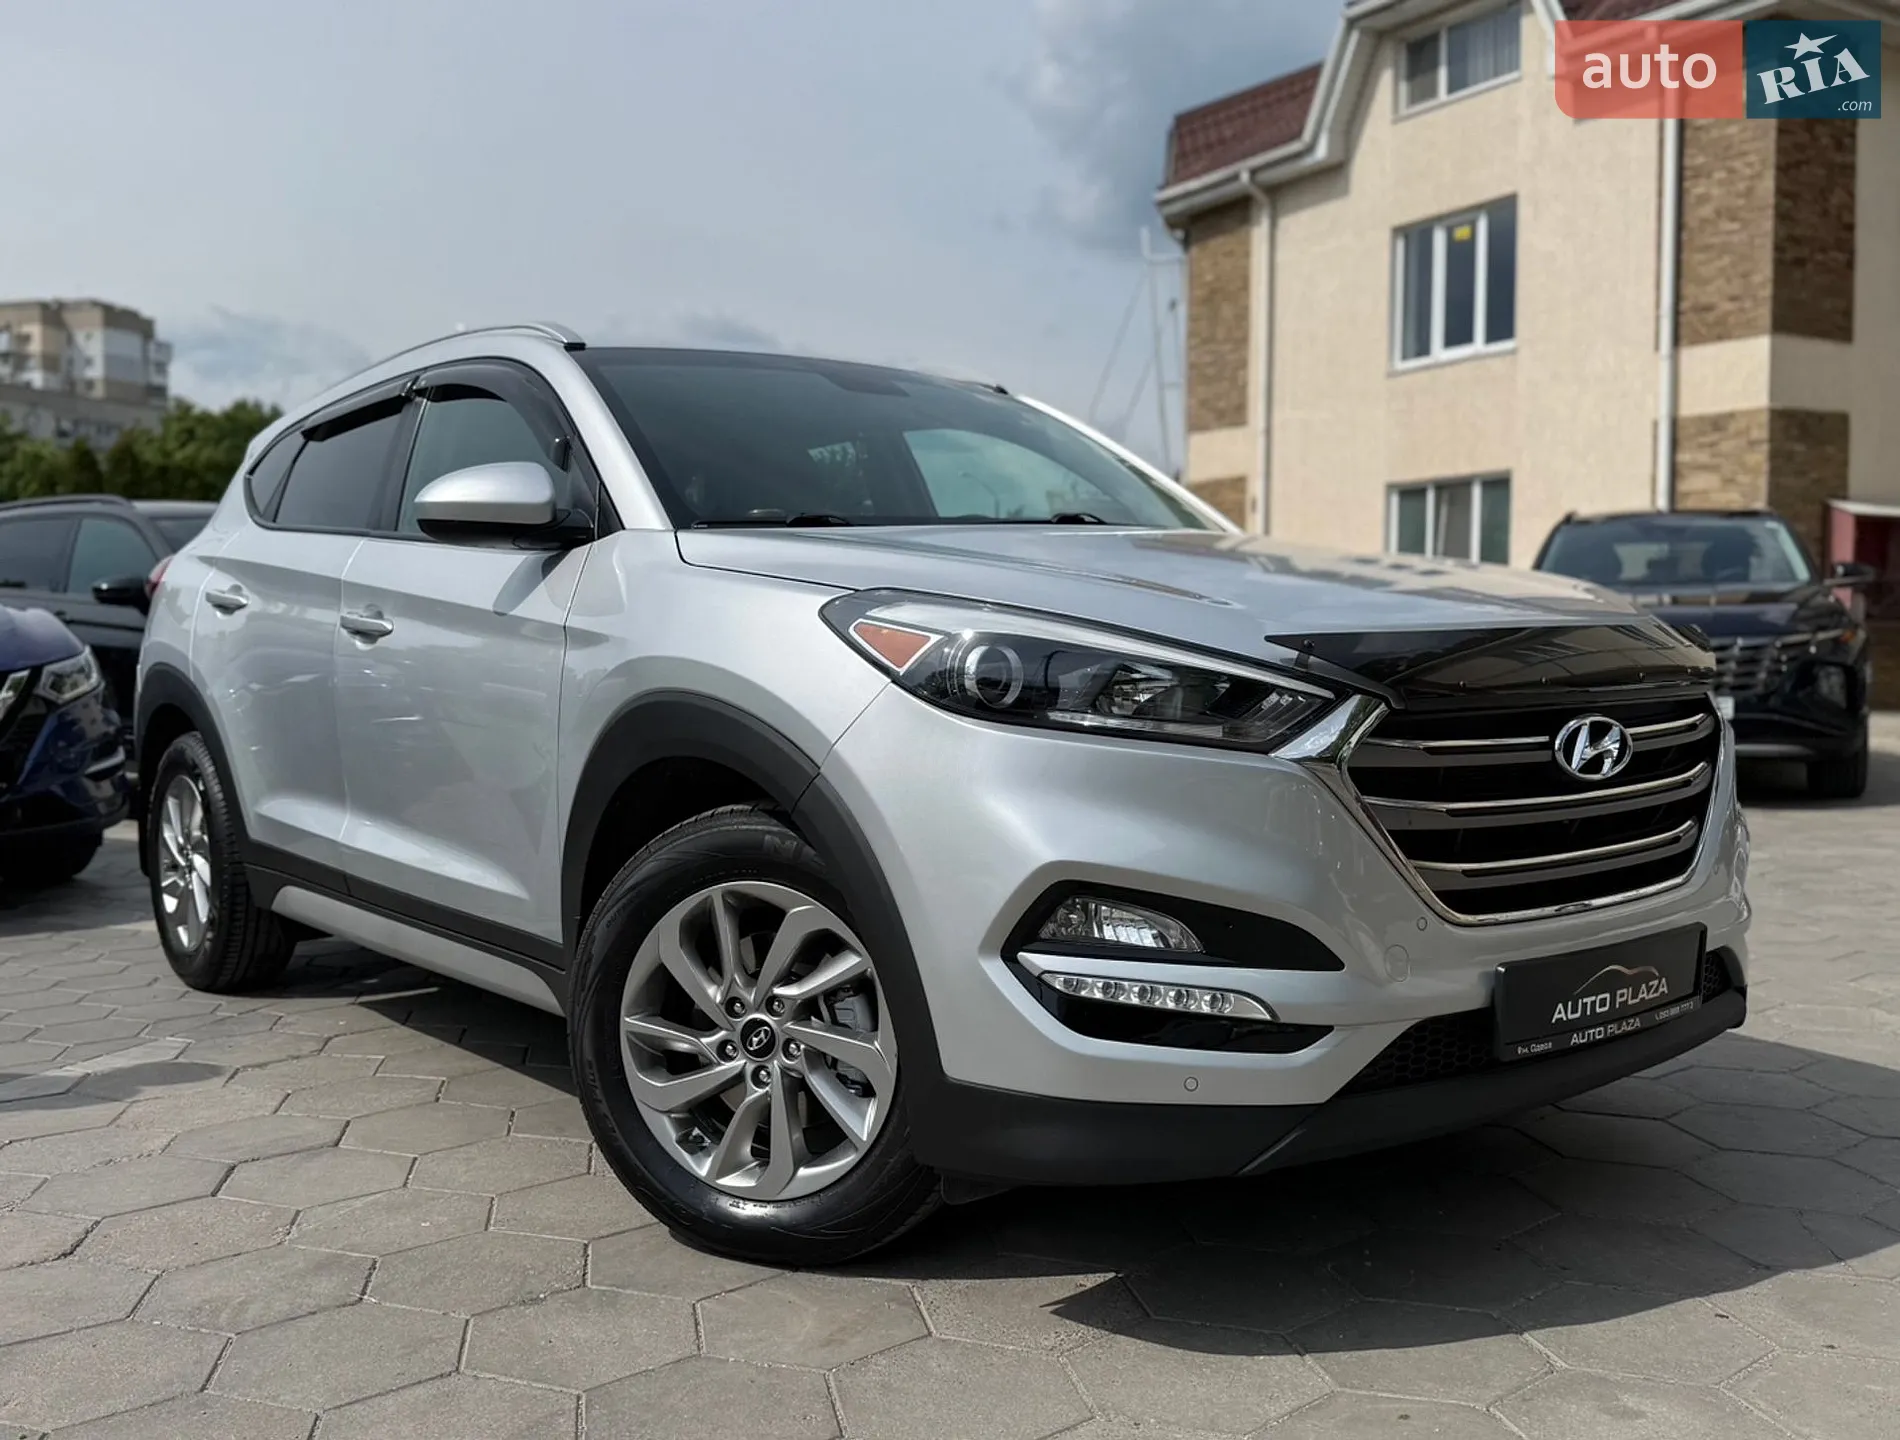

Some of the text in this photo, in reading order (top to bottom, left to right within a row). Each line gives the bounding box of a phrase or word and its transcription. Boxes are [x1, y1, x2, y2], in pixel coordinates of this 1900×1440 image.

[1551, 977, 1669, 1023] AUTO PLAZA
[1570, 1017, 1641, 1046] AUTO PLAZA
